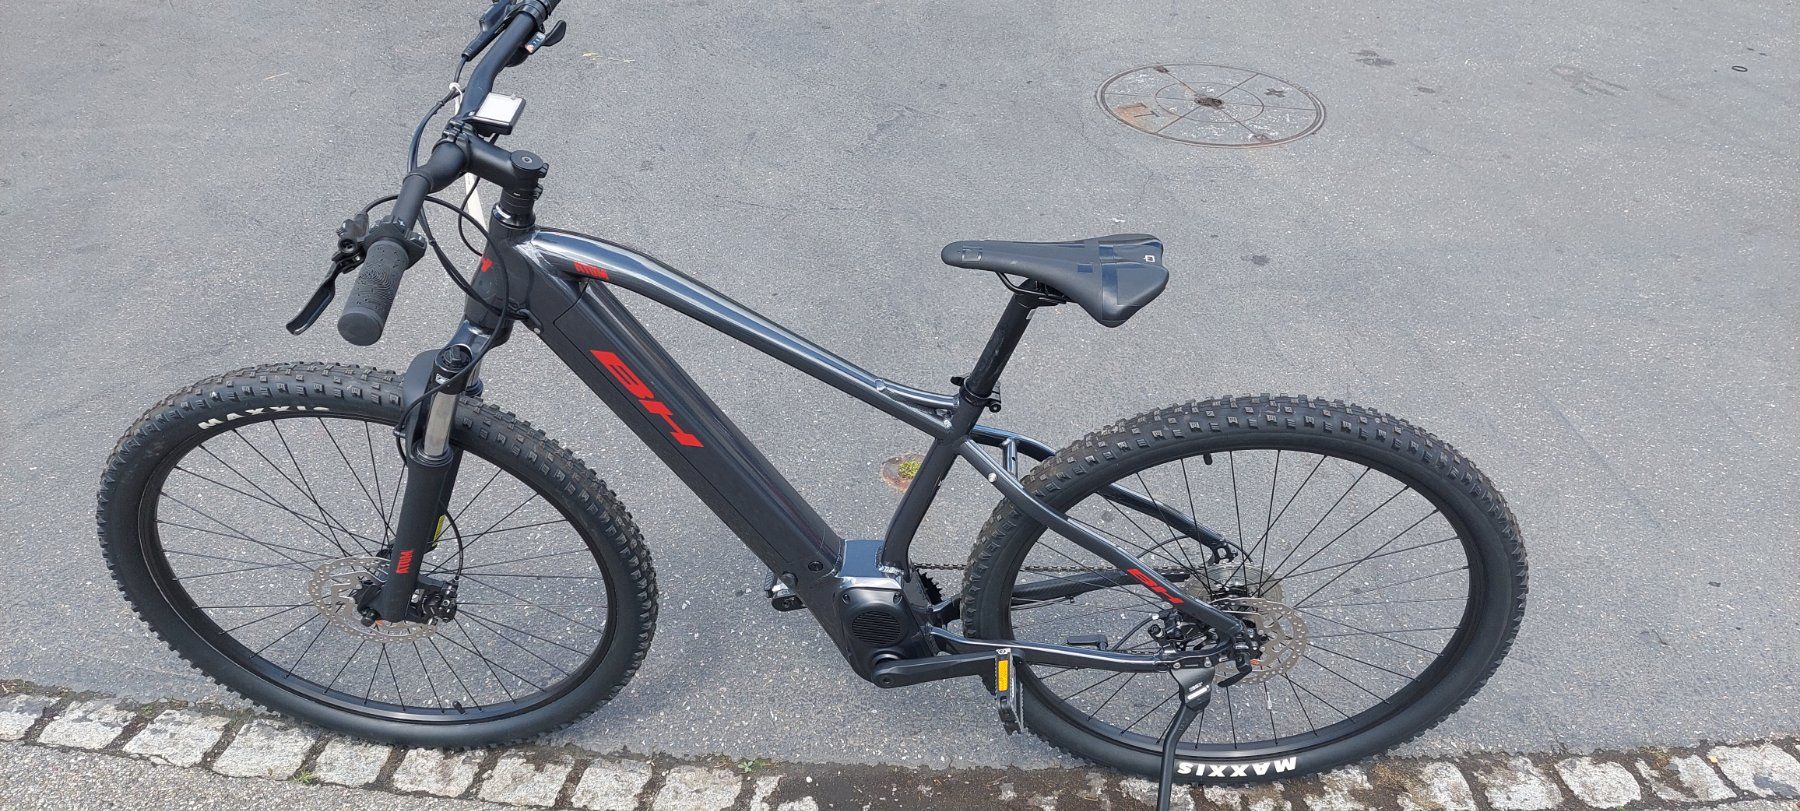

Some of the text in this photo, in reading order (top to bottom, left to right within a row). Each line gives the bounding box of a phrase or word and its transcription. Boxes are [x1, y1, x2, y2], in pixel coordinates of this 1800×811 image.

[590, 349, 704, 448] BH
[1127, 568, 1184, 604] BH
[1177, 756, 1297, 778] MAXXIS
